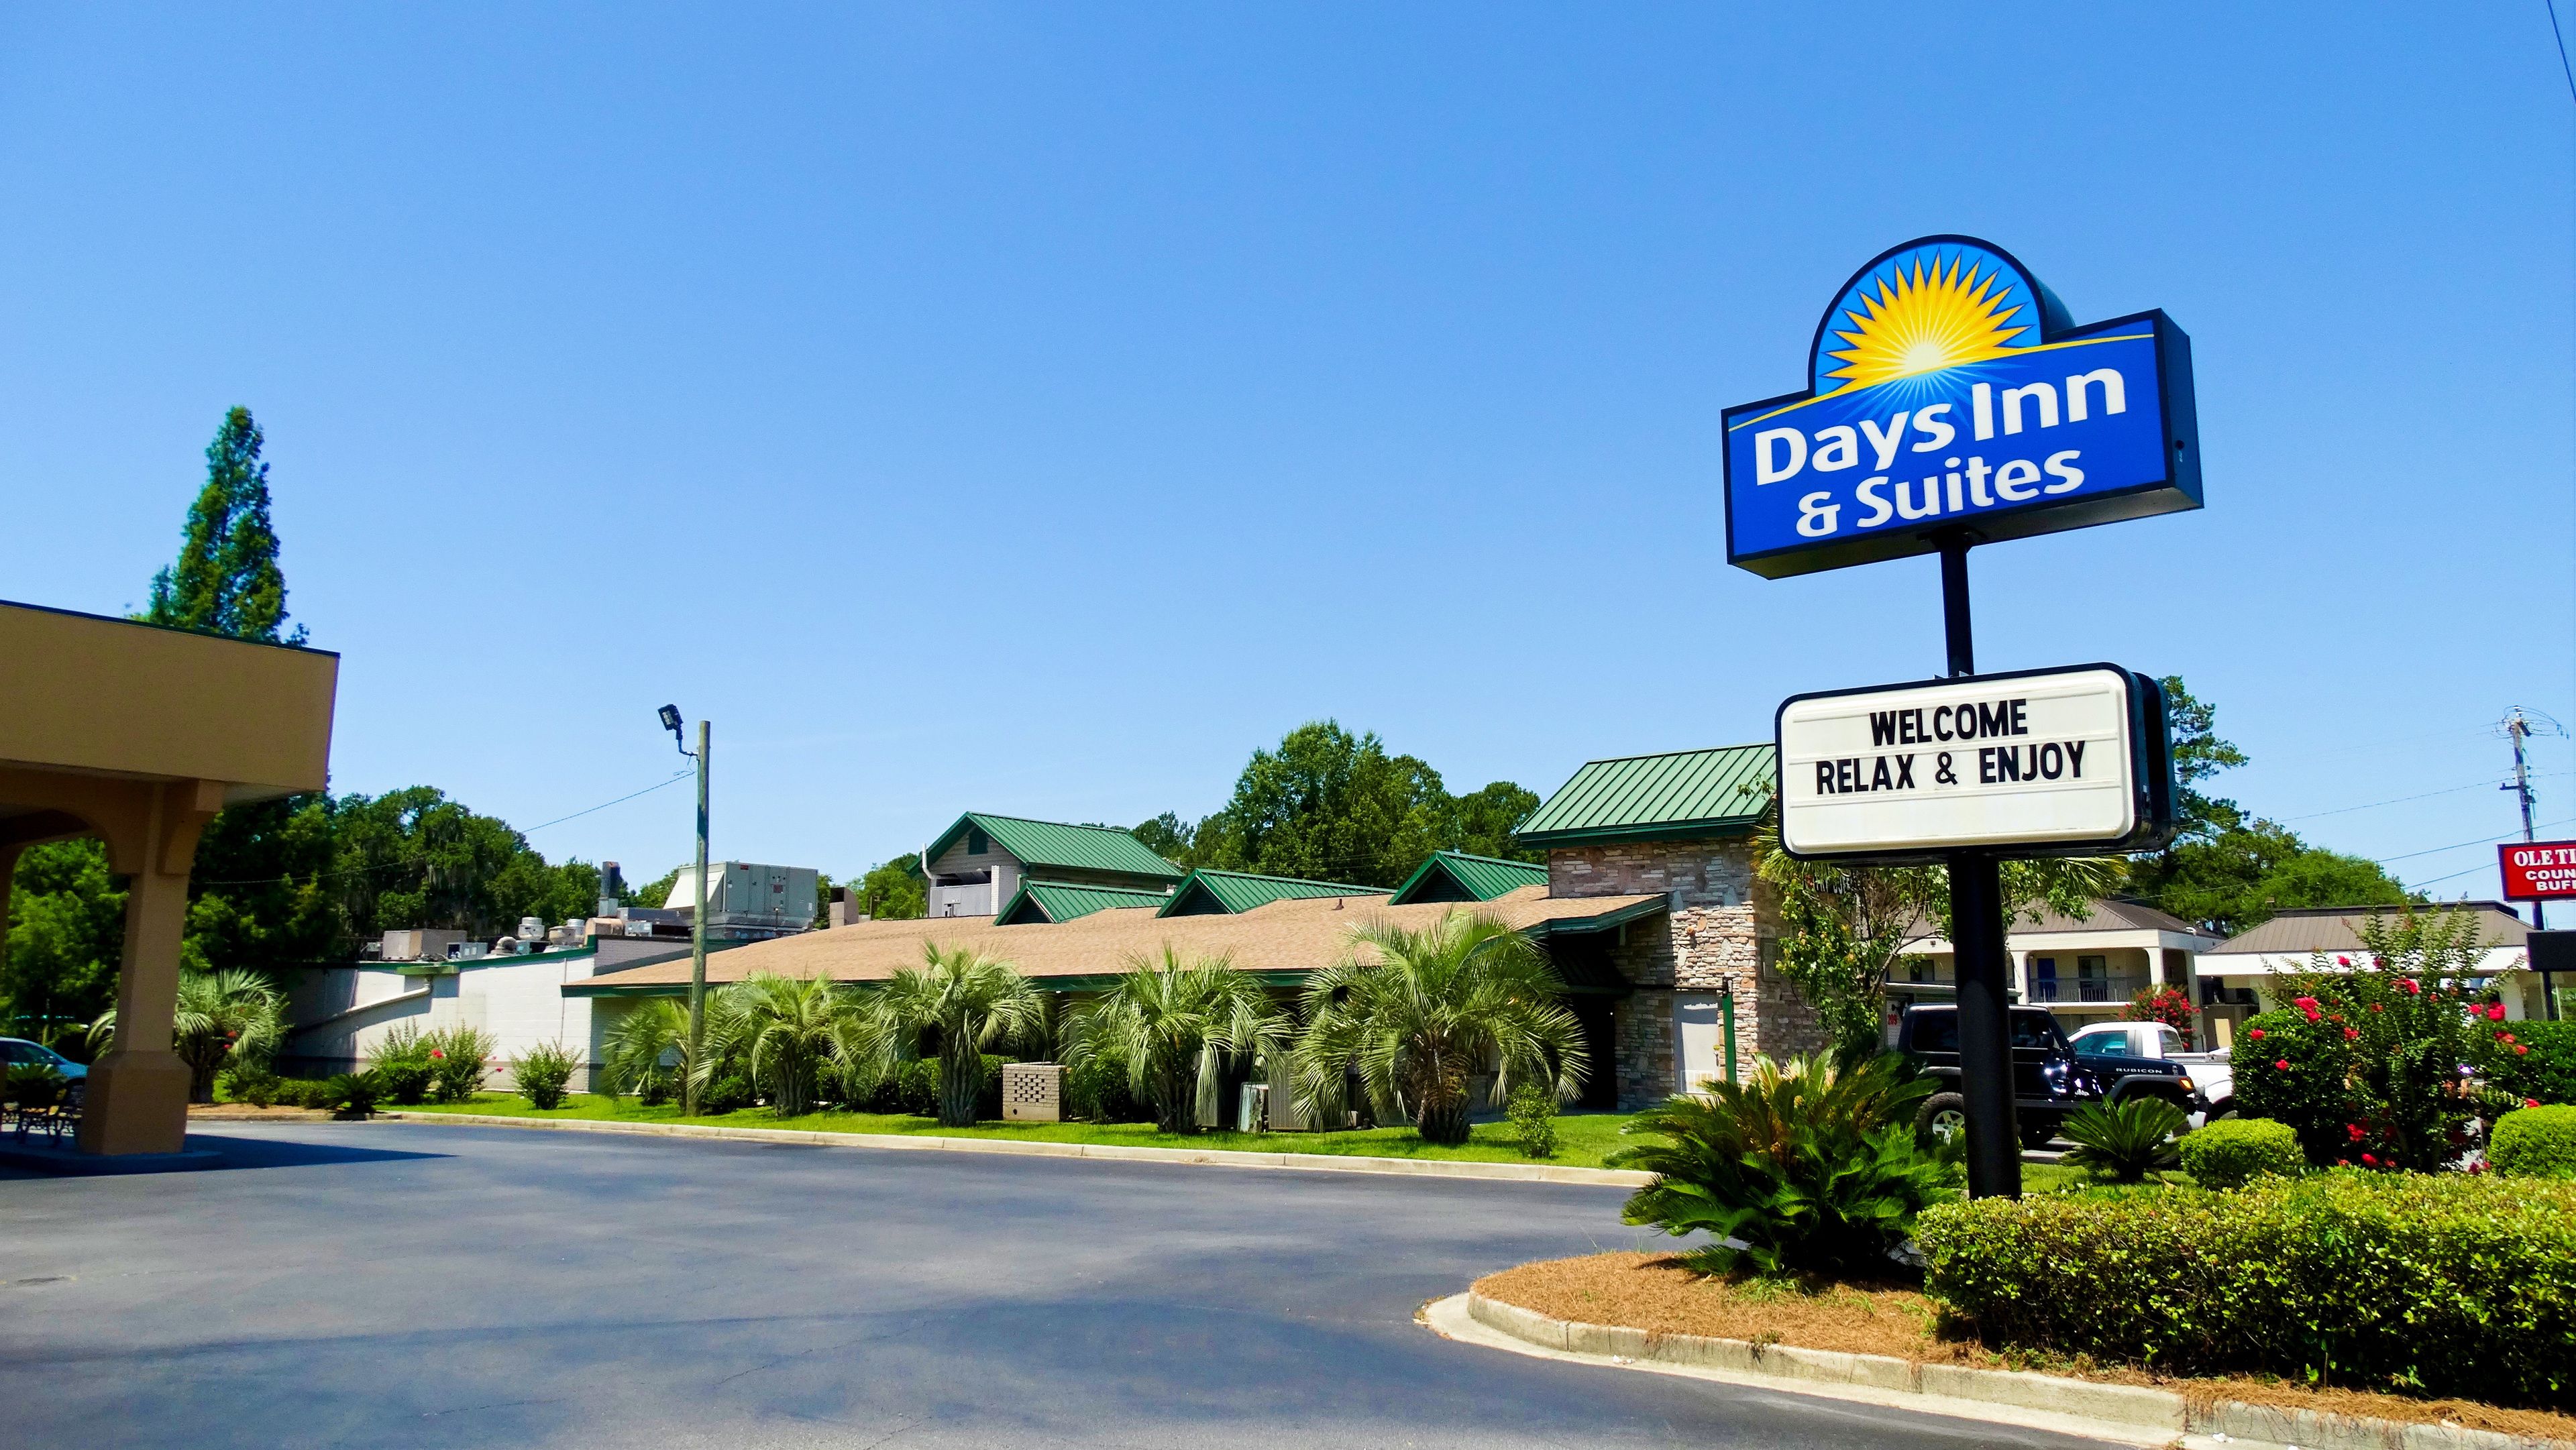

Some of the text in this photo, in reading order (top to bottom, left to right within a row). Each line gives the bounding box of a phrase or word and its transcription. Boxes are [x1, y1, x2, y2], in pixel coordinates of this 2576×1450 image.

[1755, 368, 2127, 486] Days Inn
[1796, 449, 2085, 537] & Suites
[1869, 698, 2028, 746] WELCOME
[1816, 740, 2086, 795] RELAX & ENJOY
[2514, 850, 2554, 867] OLE
[2525, 869, 2576, 881] COUN
